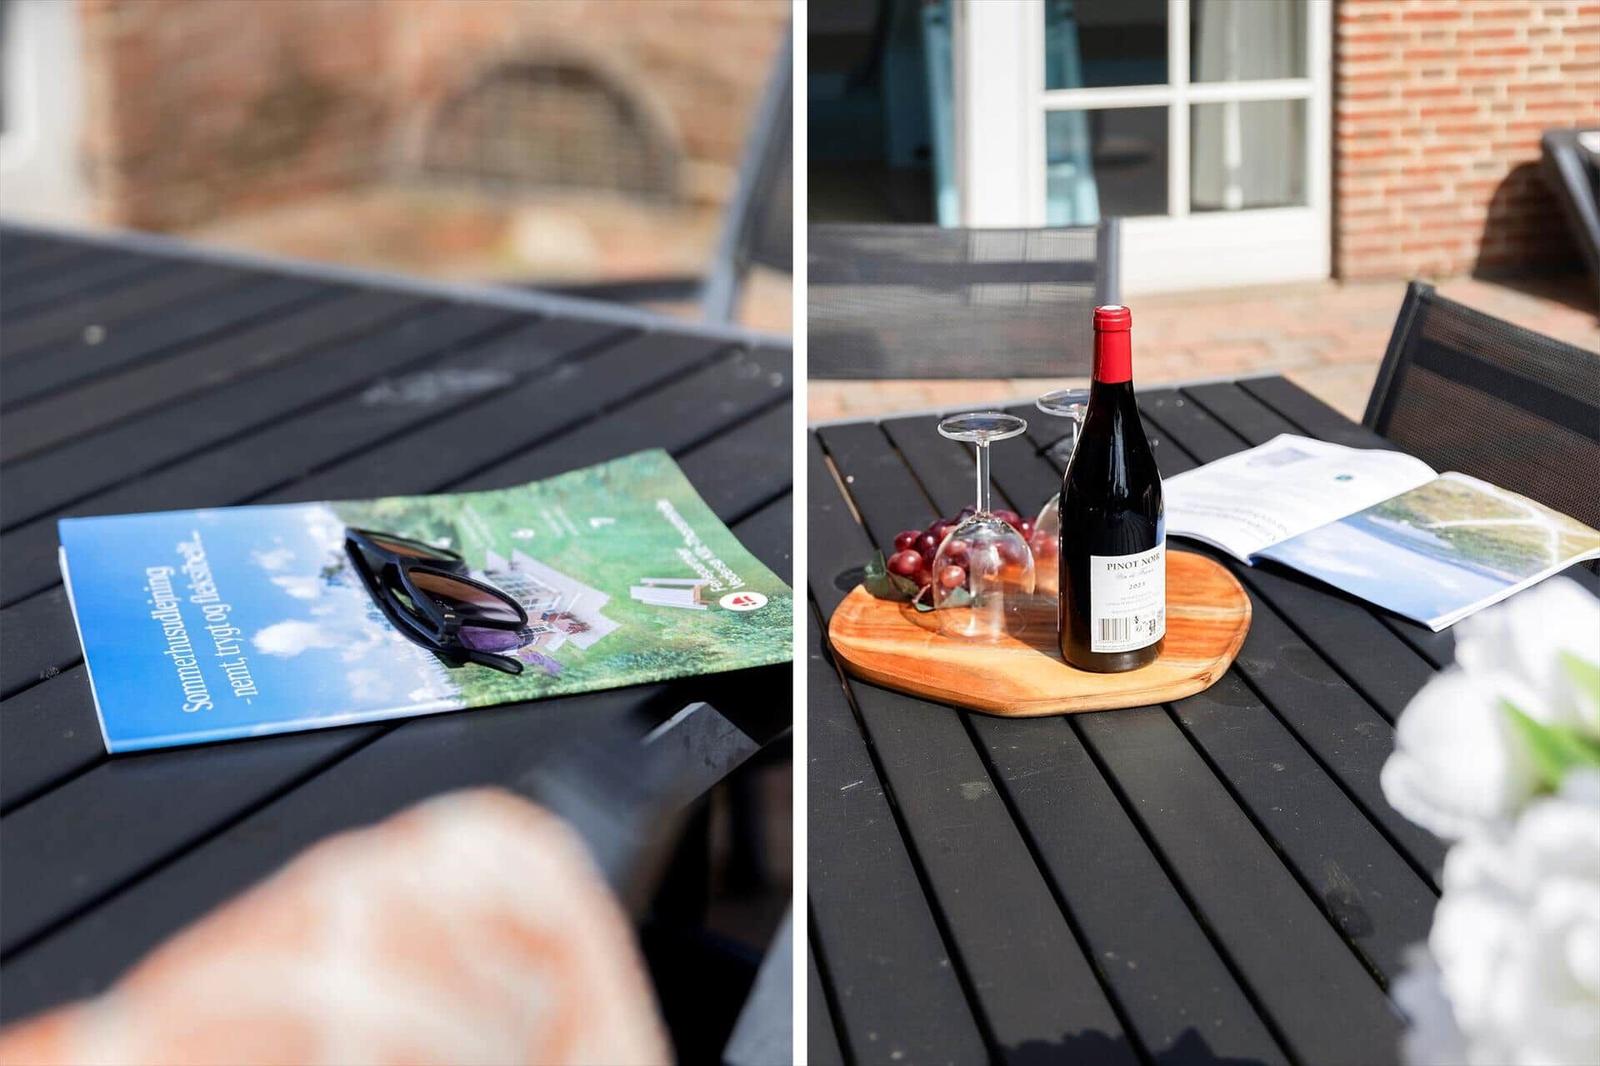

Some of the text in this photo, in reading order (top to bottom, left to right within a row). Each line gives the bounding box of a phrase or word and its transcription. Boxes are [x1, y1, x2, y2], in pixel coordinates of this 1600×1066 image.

[1106, 552, 1160, 571] PINOT NOIR
[202, 603, 232, 622] og
[144, 566, 214, 713] Sommerhusudlejning
[204, 622, 244, 657] trygt
